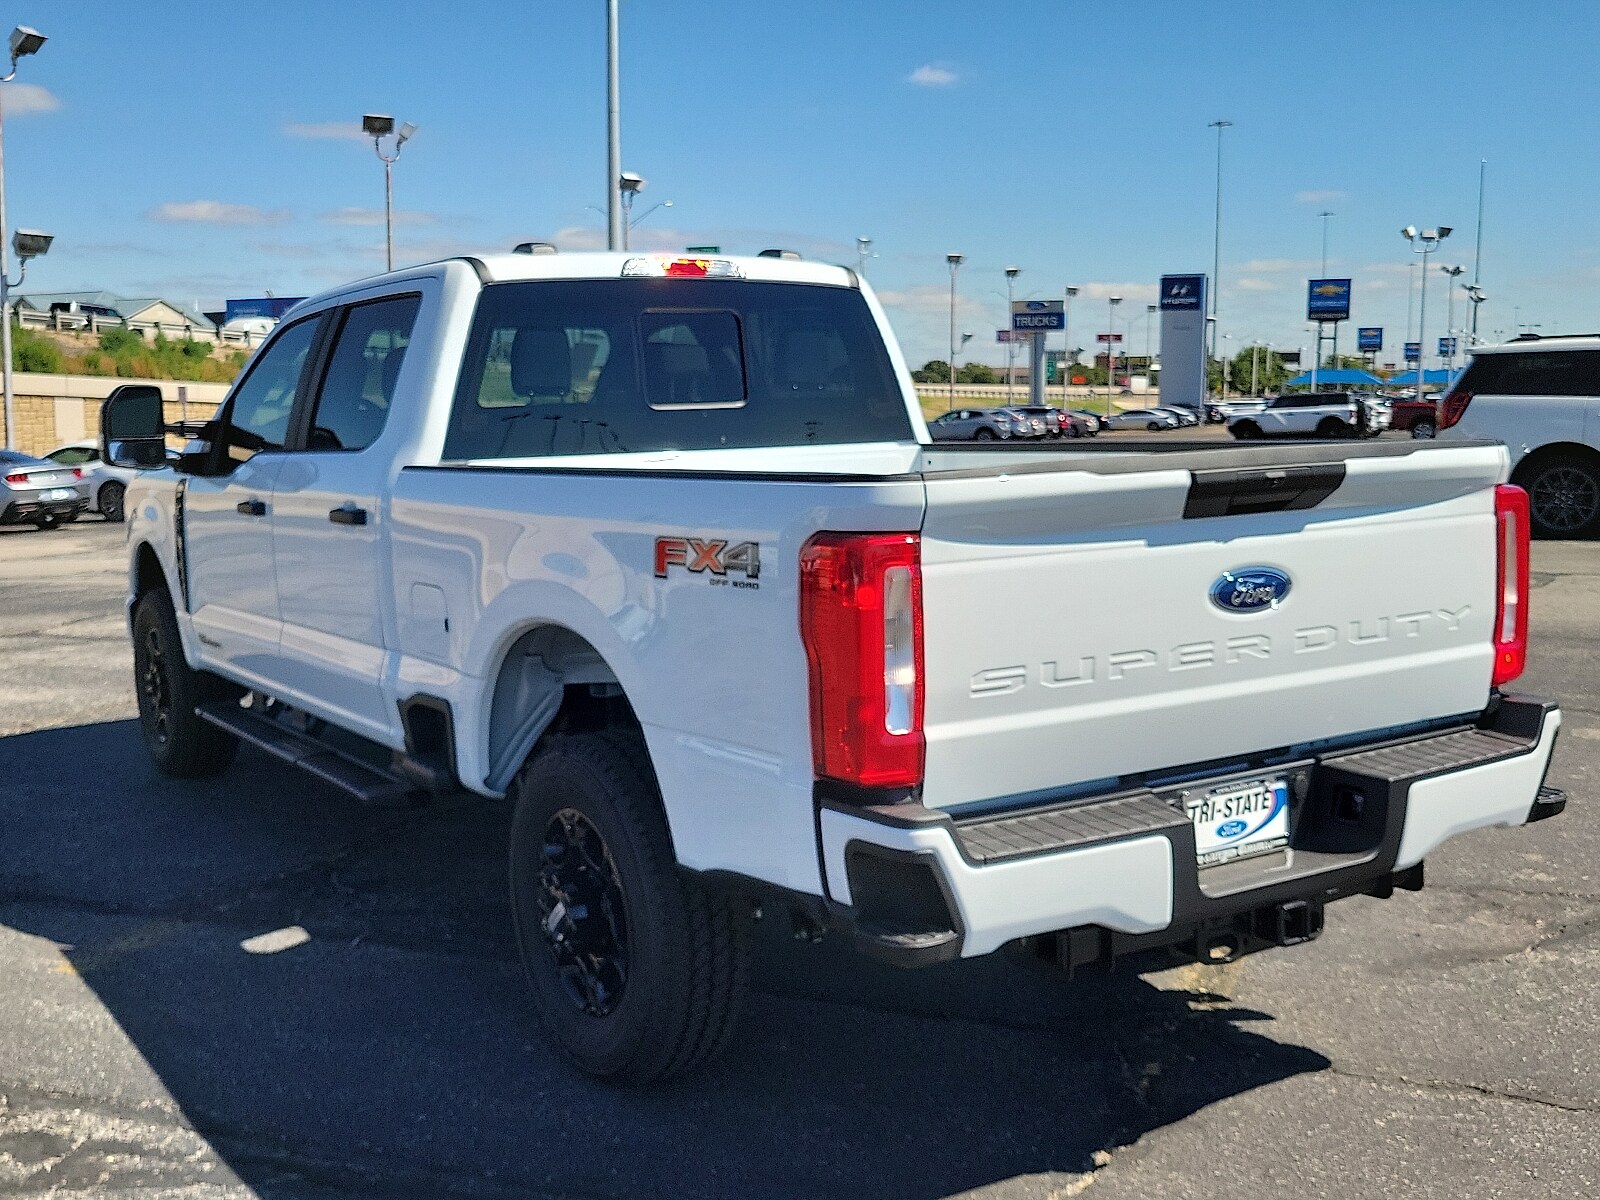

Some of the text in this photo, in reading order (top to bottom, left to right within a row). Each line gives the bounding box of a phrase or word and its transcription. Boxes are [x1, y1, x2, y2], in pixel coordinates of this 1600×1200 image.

[1015, 317, 1057, 327] TRUCKS
[655, 536, 760, 579] FX4
[732, 581, 759, 590] ROAD
[970, 604, 1471, 698] SUPER DUTY
[1187, 791, 1273, 824] TRI-STATE
